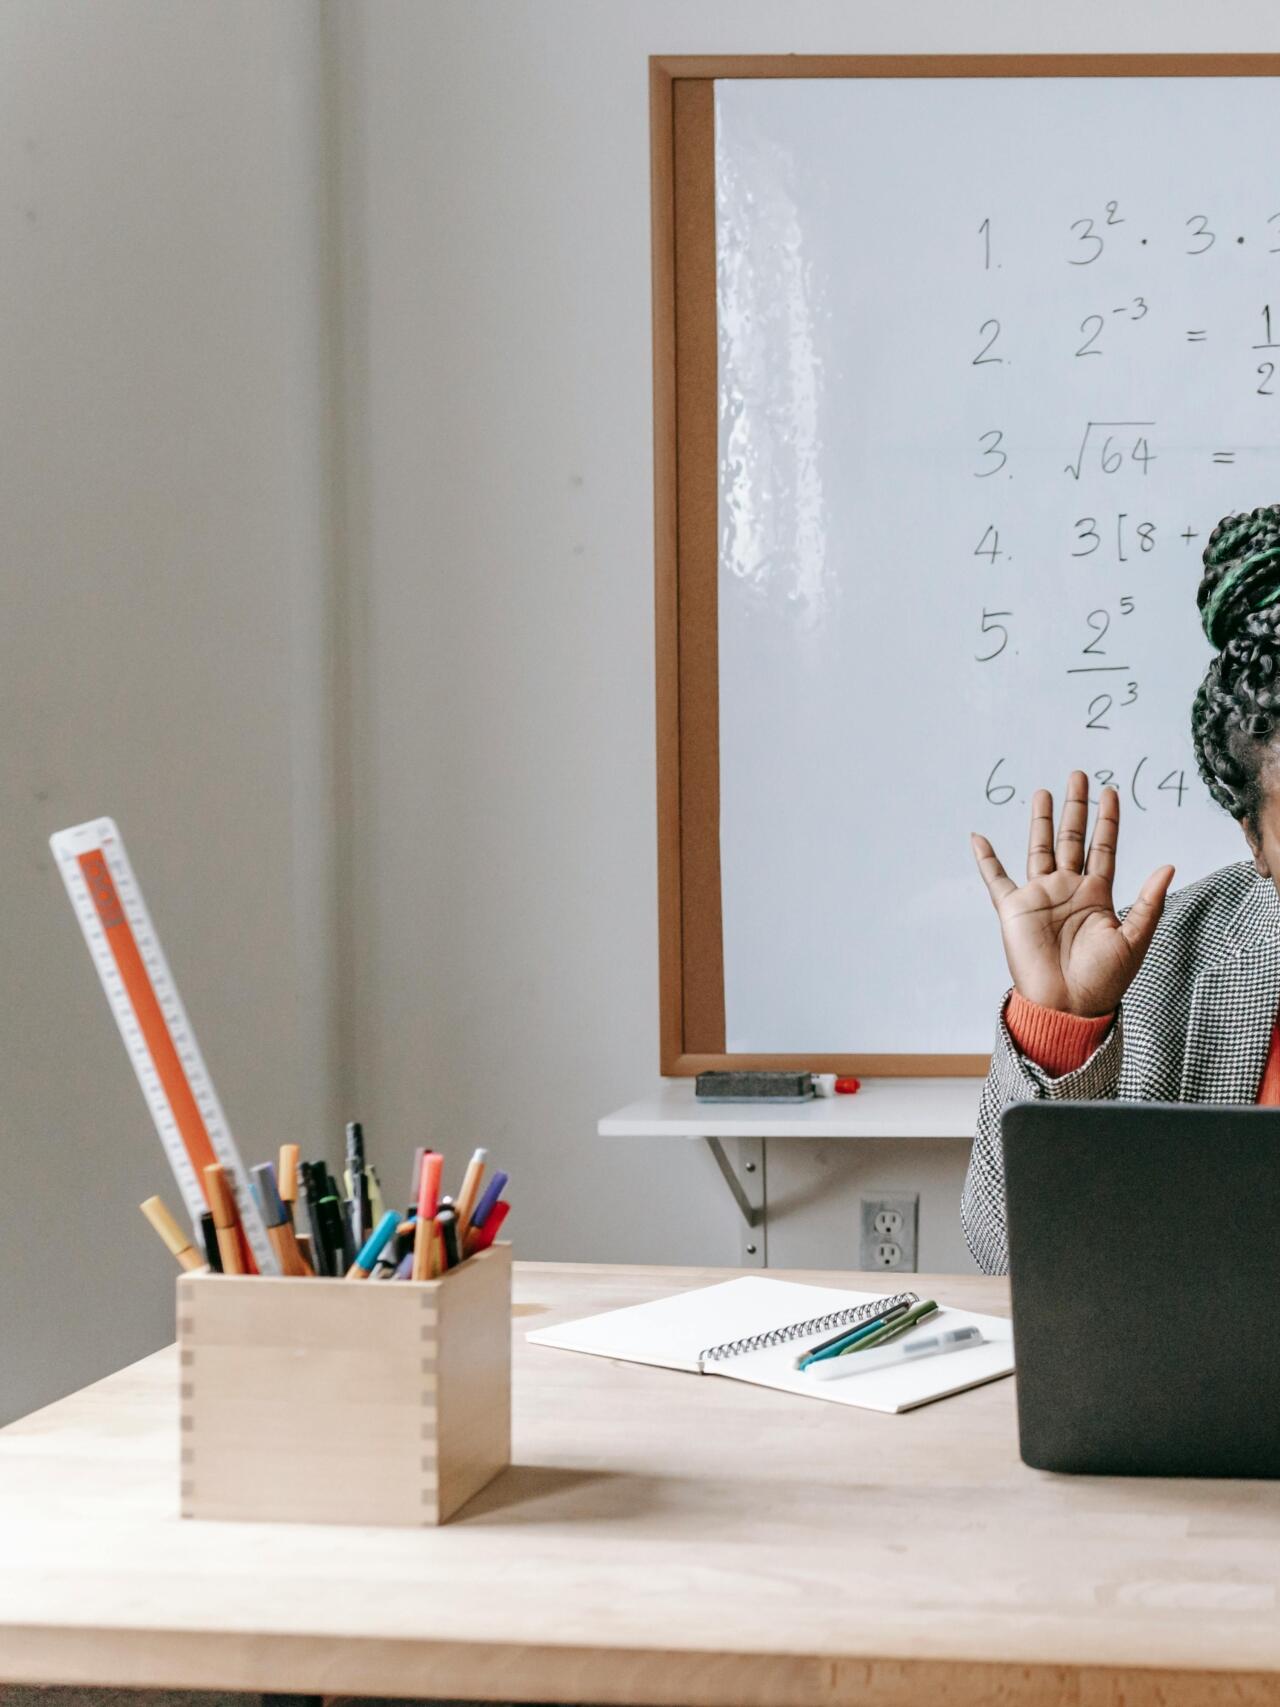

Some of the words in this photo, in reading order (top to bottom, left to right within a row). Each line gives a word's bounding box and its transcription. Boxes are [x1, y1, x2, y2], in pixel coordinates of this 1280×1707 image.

[977, 217, 1002, 270] 1.
[972, 318, 1012, 366] 2.
[973, 430, 1014, 480] 3.
[973, 524, 1013, 565] 4.
[974, 607, 1020, 663] 5.
[984, 757, 1027, 806] 6.
